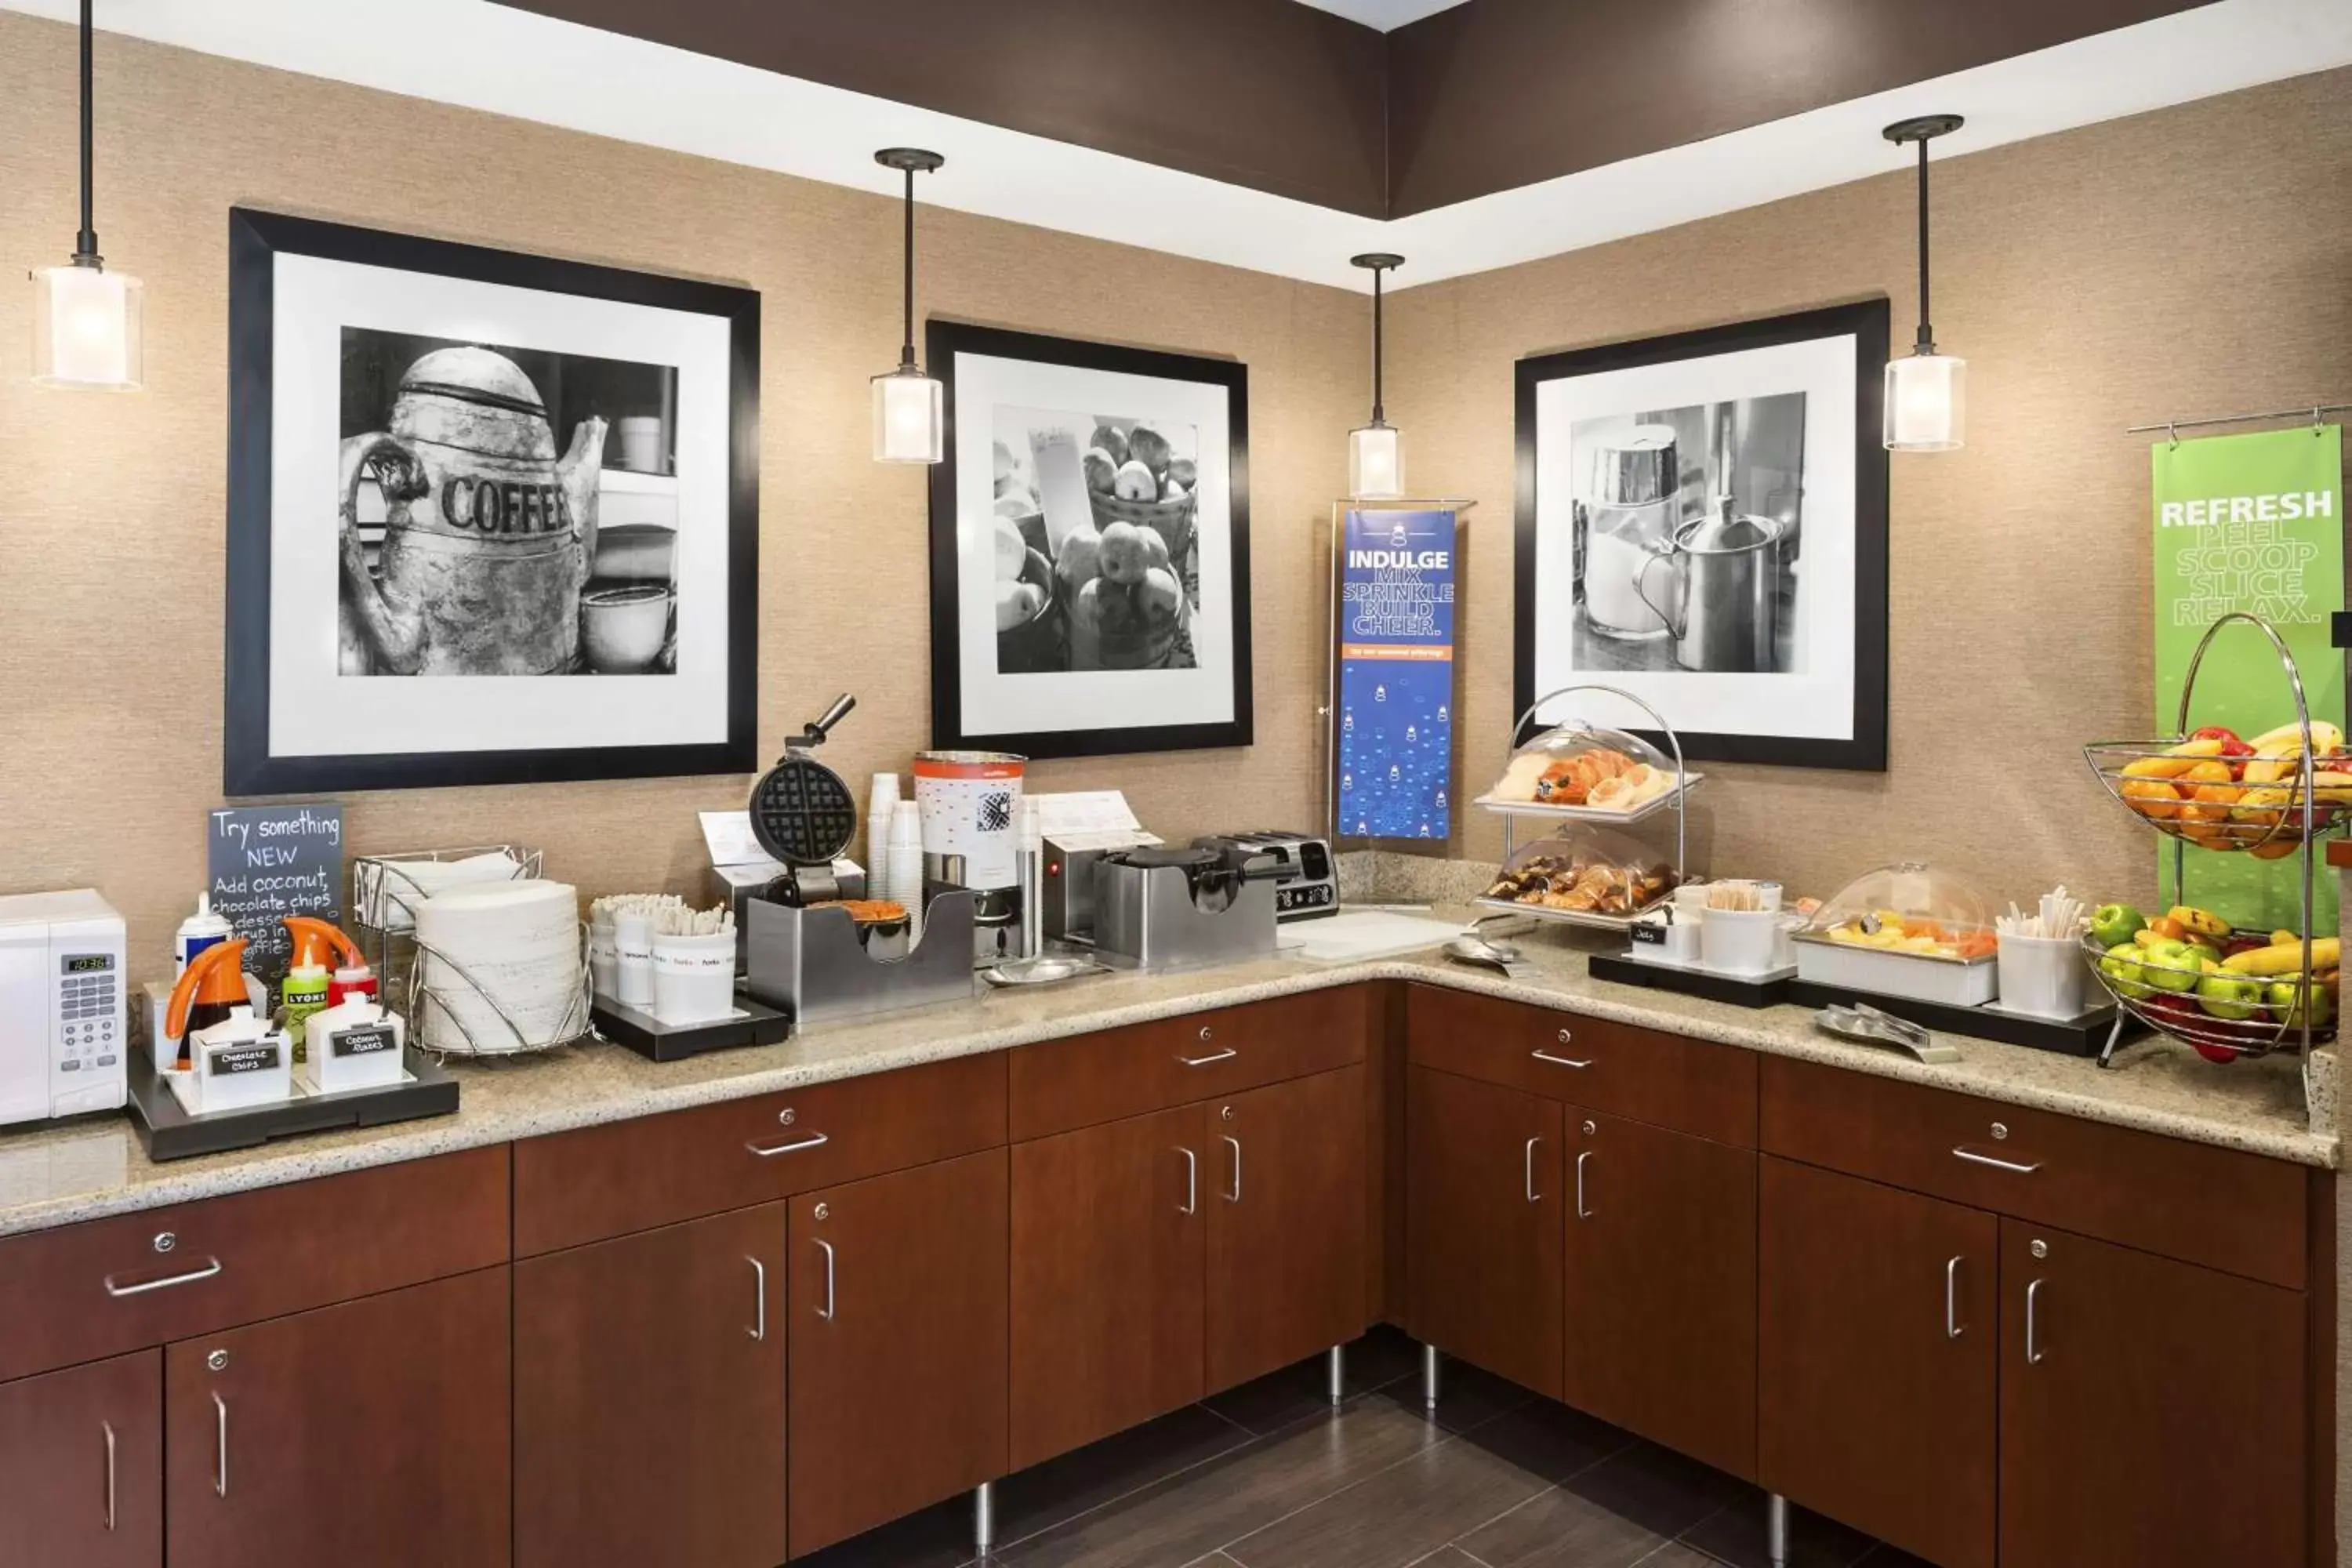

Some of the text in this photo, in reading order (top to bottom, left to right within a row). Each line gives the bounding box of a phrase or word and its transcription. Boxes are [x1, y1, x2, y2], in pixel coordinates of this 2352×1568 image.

[442, 477, 568, 533] COFFEE
[2161, 490, 2332, 528] REFRESH
[2196, 520, 2296, 549] PEEL
[1348, 550, 1450, 569] INDULGE
[2176, 542, 2319, 576] SCOOP
[1375, 568, 1423, 585] MIX
[2190, 568, 2304, 600] SLICE
[1342, 583, 1455, 602] SPRINKLE
[1360, 601, 1435, 618] BUILD
[2173, 594, 2321, 626] RELAX.
[1352, 615, 1443, 636] CHEER.
[212, 809, 339, 850] Try something
[247, 846, 297, 868] NEW
[214, 865, 328, 894] Add coconut,
[212, 892, 332, 914] chocolate chips
[272, 926, 286, 937] in
